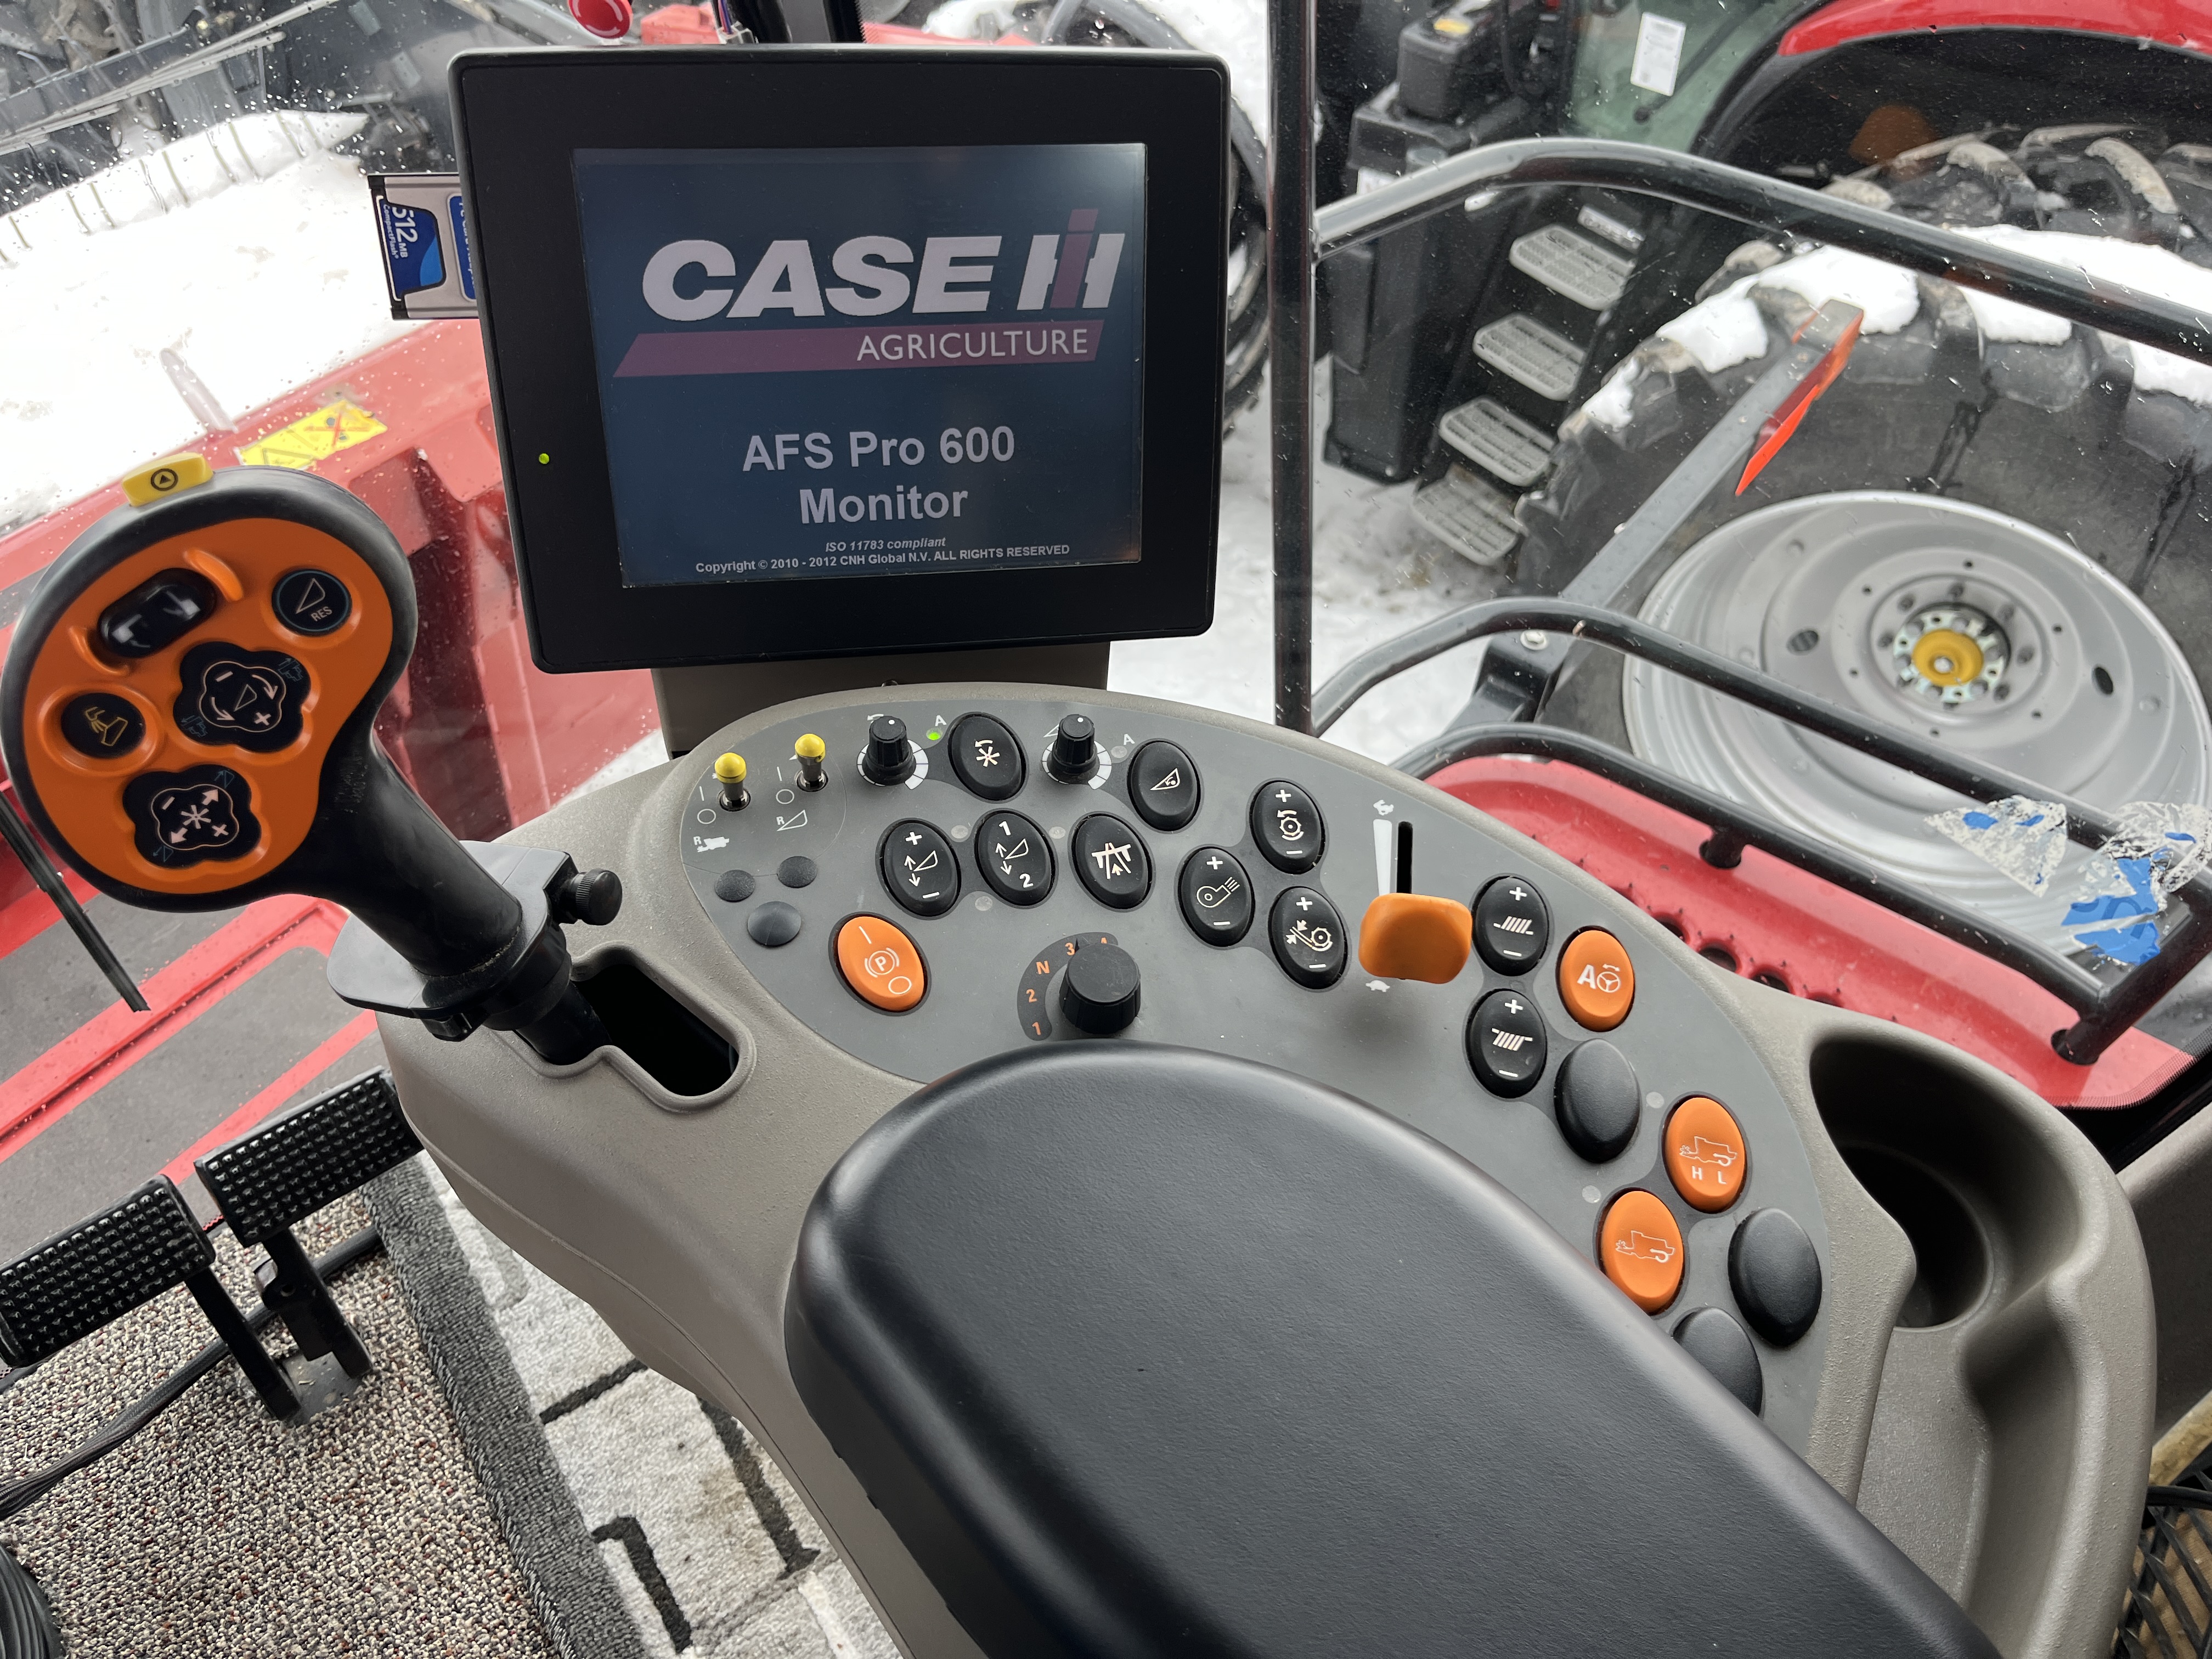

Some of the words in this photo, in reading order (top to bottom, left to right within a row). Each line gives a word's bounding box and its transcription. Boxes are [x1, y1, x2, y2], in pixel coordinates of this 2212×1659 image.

[642, 236, 1002, 321] CASE
[856, 329, 1088, 360] AGRICULTURE
[742, 432, 833, 471] AFS
[849, 431, 925, 467] Pro
[940, 426, 1015, 464] 600
[799, 485, 968, 524] Monitor
[825, 541, 847, 552] ISO
[850, 540, 884, 551] 11783
[887, 537, 946, 550] compliant
[696, 560, 757, 574] Copyright
[771, 558, 799, 569] 2010
[809, 556, 837, 567] 2012
[840, 555, 865, 566] CNH
[868, 553, 905, 564] Global
[909, 552, 931, 562] N.V.
[934, 551, 957, 561] ALL
[960, 548, 1003, 560] RIGHTS
[1007, 544, 1070, 557] RESERVED
[311, 606, 332, 622] RES
[935, 715, 947, 727] A
[1123, 733, 1135, 746] A
[776, 816, 785, 825] R
[998, 821, 1011, 836] 1
[693, 836, 702, 845] R
[1019, 873, 1034, 888] 2
[1065, 943, 1075, 956] 3
[874, 956, 887, 972] P
[1036, 961, 1050, 974] N
[1577, 964, 1596, 989] A
[1026, 989, 1037, 1003] 2
[1032, 1022, 1041, 1035] 1
[1691, 1165, 1702, 1180] H
[1718, 1171, 1727, 1184] L
